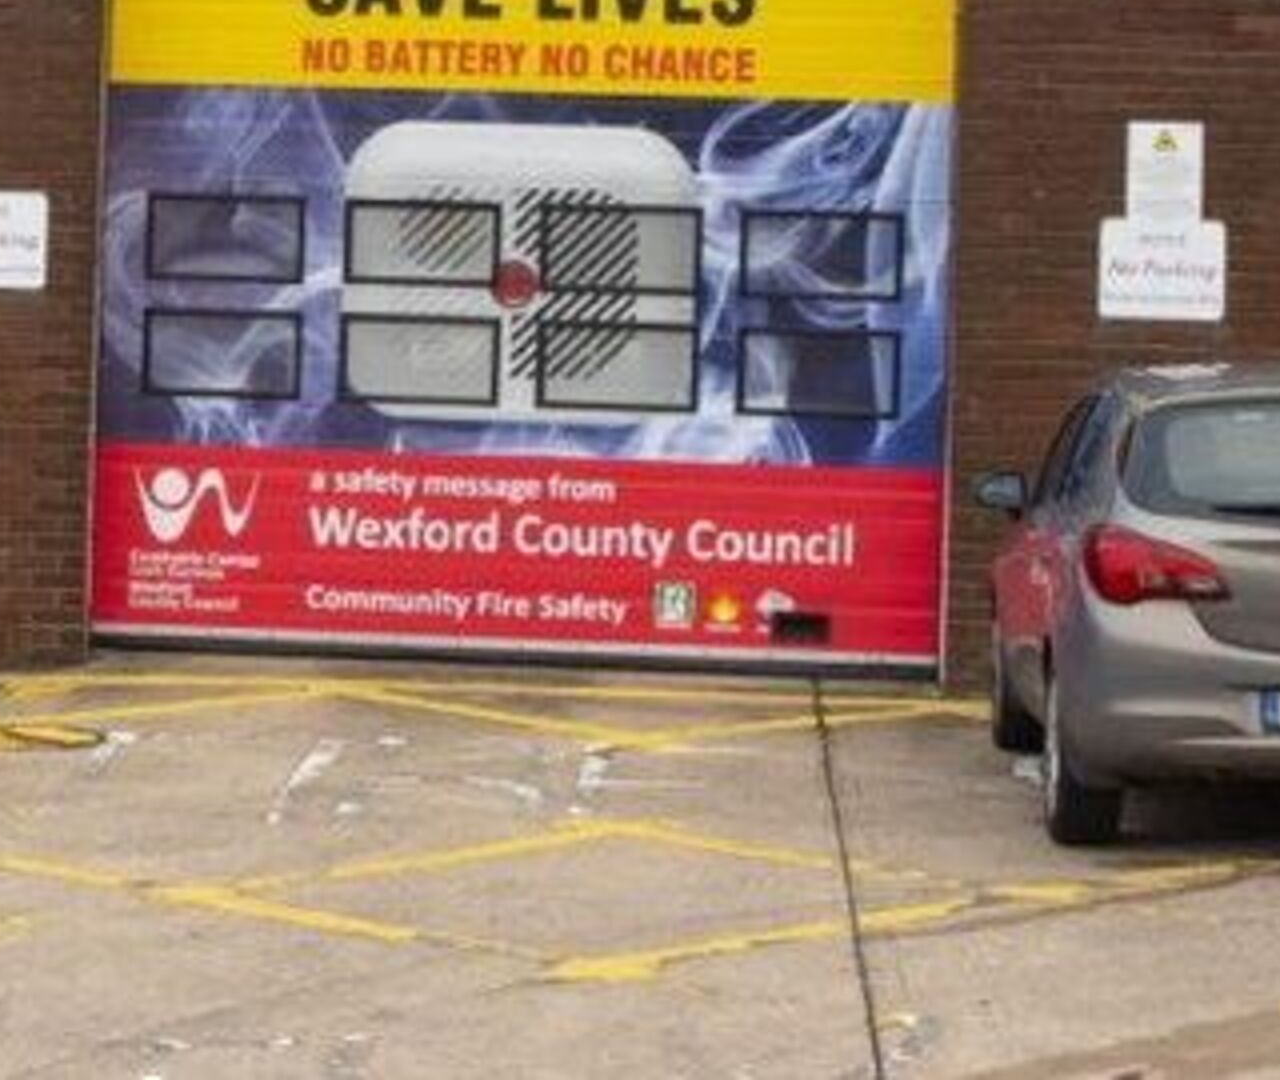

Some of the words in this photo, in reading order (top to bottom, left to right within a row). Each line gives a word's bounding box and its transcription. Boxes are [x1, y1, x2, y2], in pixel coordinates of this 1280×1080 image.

[300, 37, 349, 73] NO
[365, 38, 526, 77] BATTERY
[539, 42, 590, 79] NO
[603, 45, 757, 84] CHANCE
[308, 473, 325, 493] a
[332, 467, 416, 500] safety
[422, 474, 541, 505] message
[547, 473, 617, 503] from
[307, 505, 501, 552] Wexford
[513, 514, 675, 568] County
[686, 519, 855, 566] Council
[306, 584, 471, 619] Community
[477, 587, 525, 618] Fire
[539, 591, 628, 624] Safety
